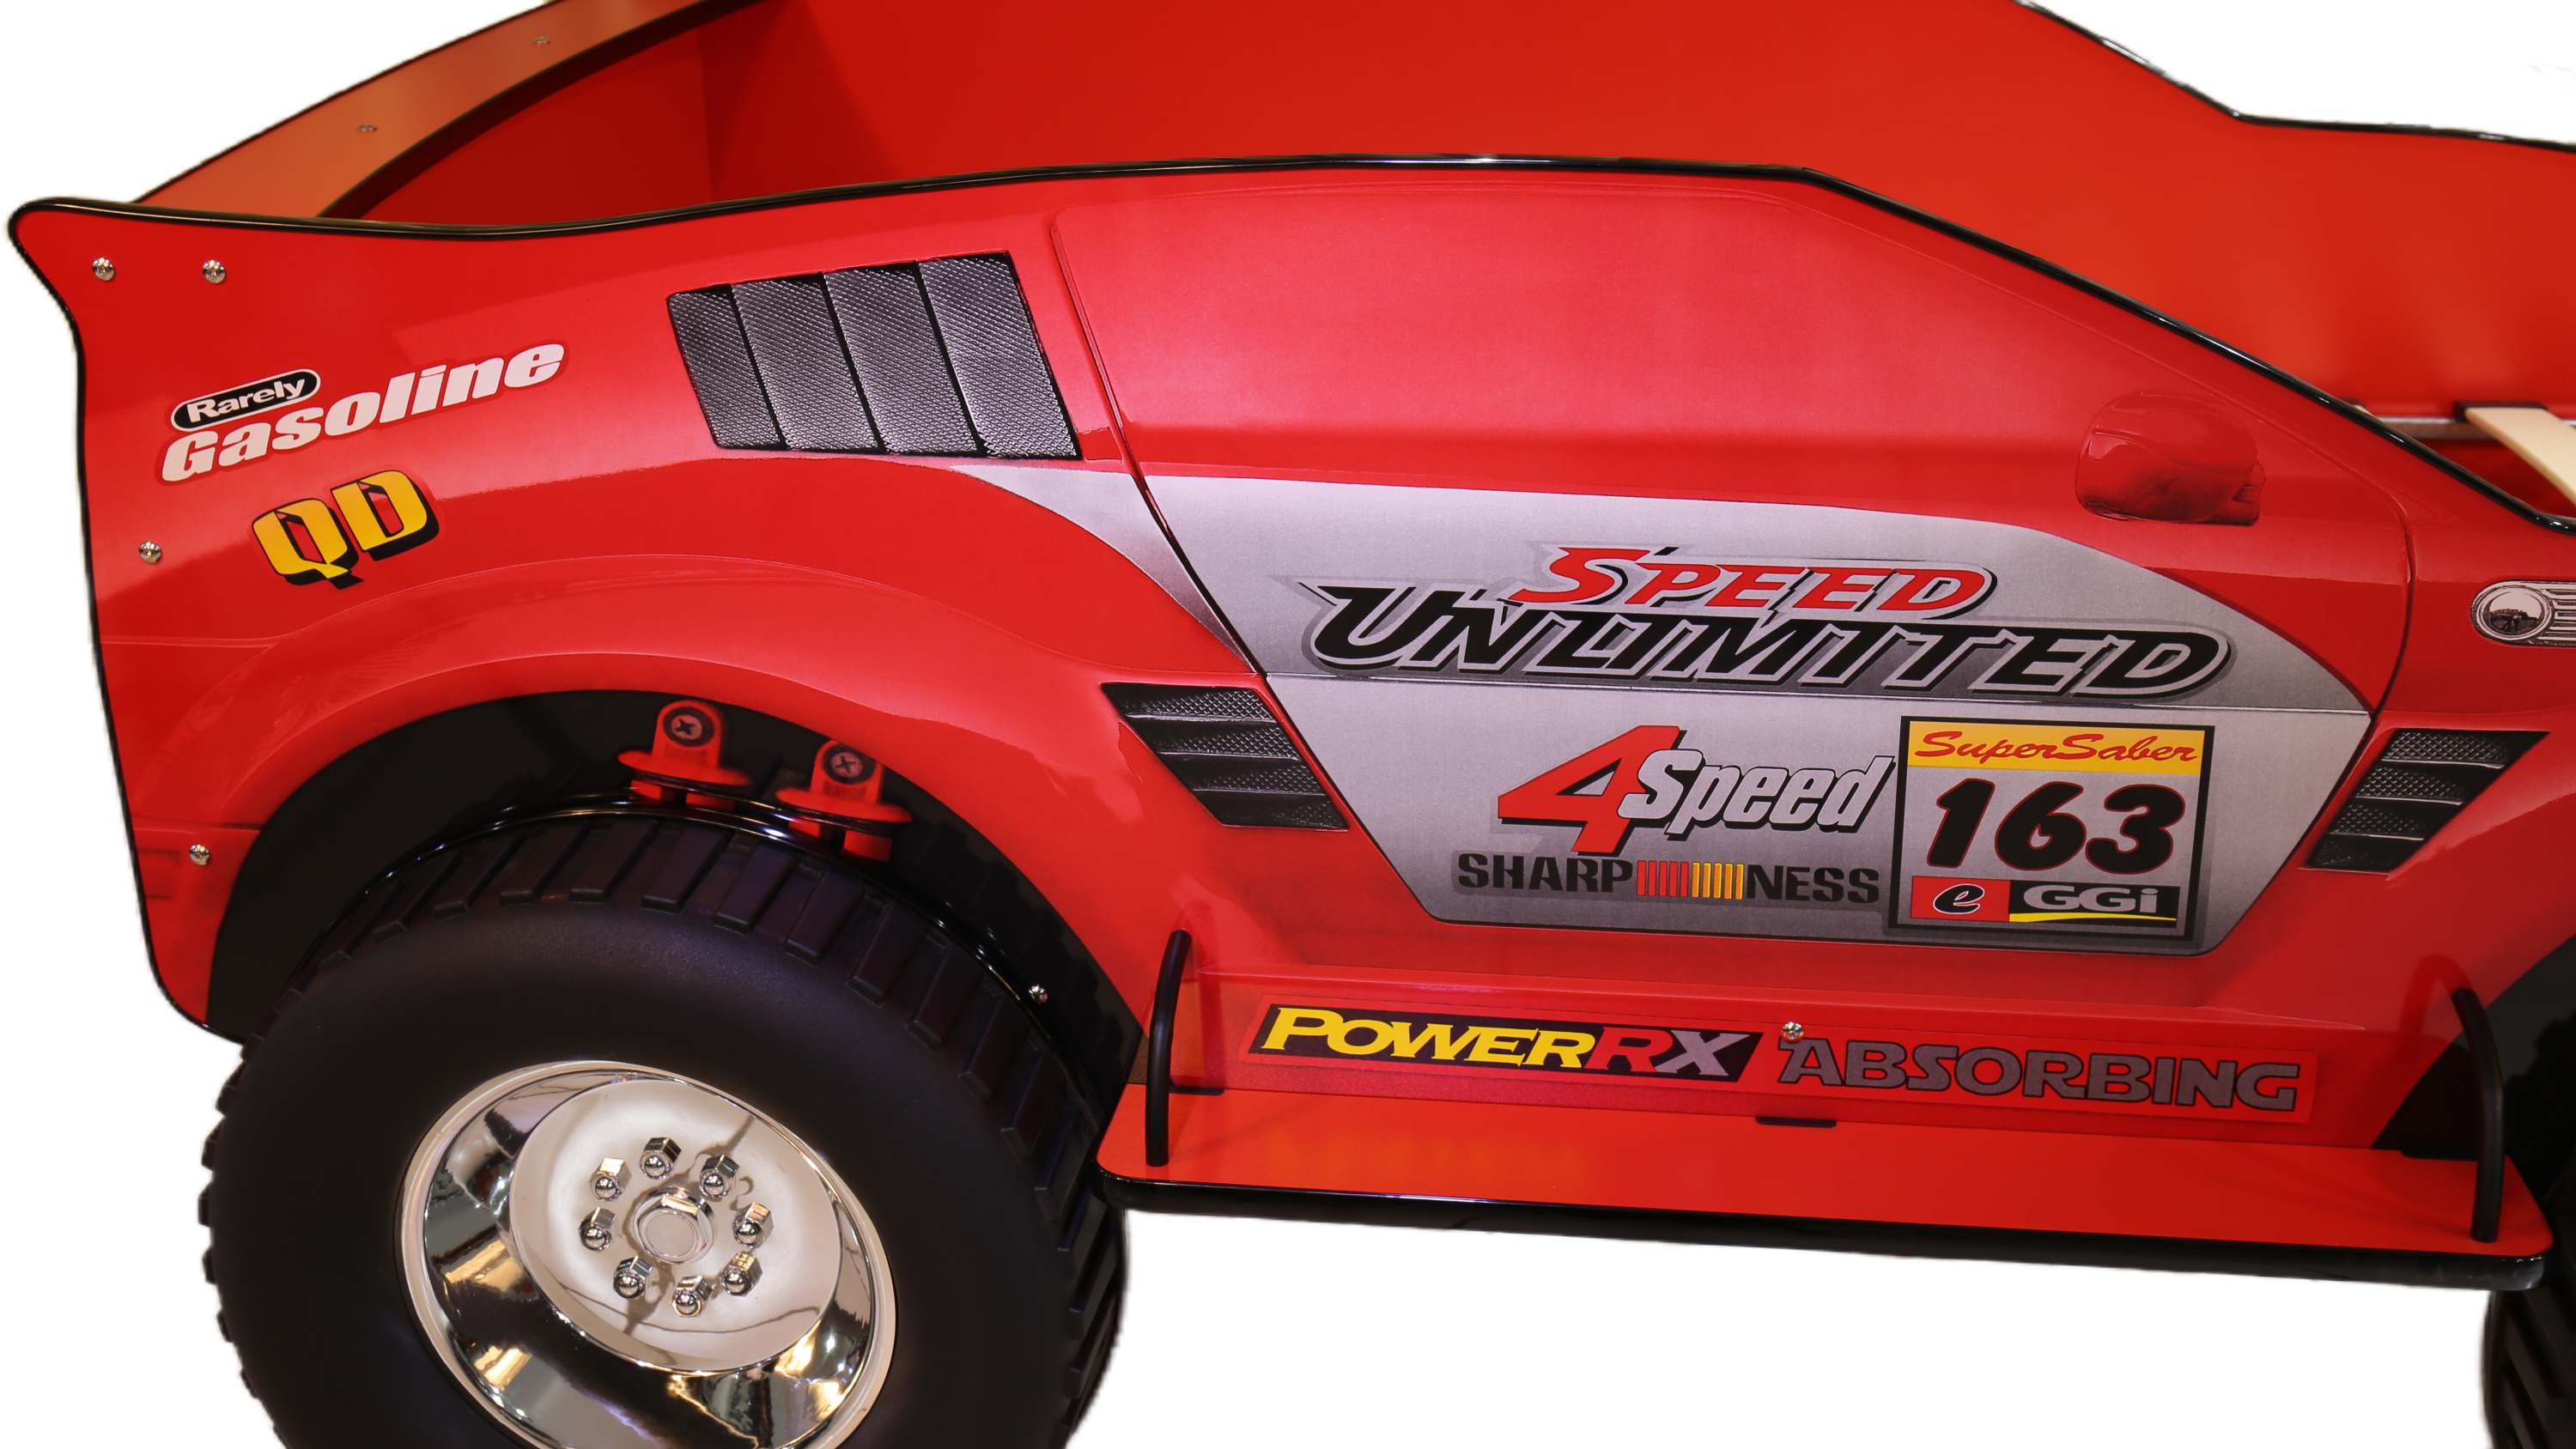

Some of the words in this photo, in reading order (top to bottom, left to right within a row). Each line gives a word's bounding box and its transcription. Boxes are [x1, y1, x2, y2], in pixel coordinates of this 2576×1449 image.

[161, 343, 566, 482] Gasoline
[188, 379, 307, 423] Rarely
[252, 470, 440, 590] QD
[1301, 583, 2233, 697] UNLIMITED
[1926, 777, 2186, 874] 163
[1457, 852, 1634, 894] SHARP
[1748, 865, 1880, 904] NESS
[1777, 1036, 2299, 1112] ABSORBING
